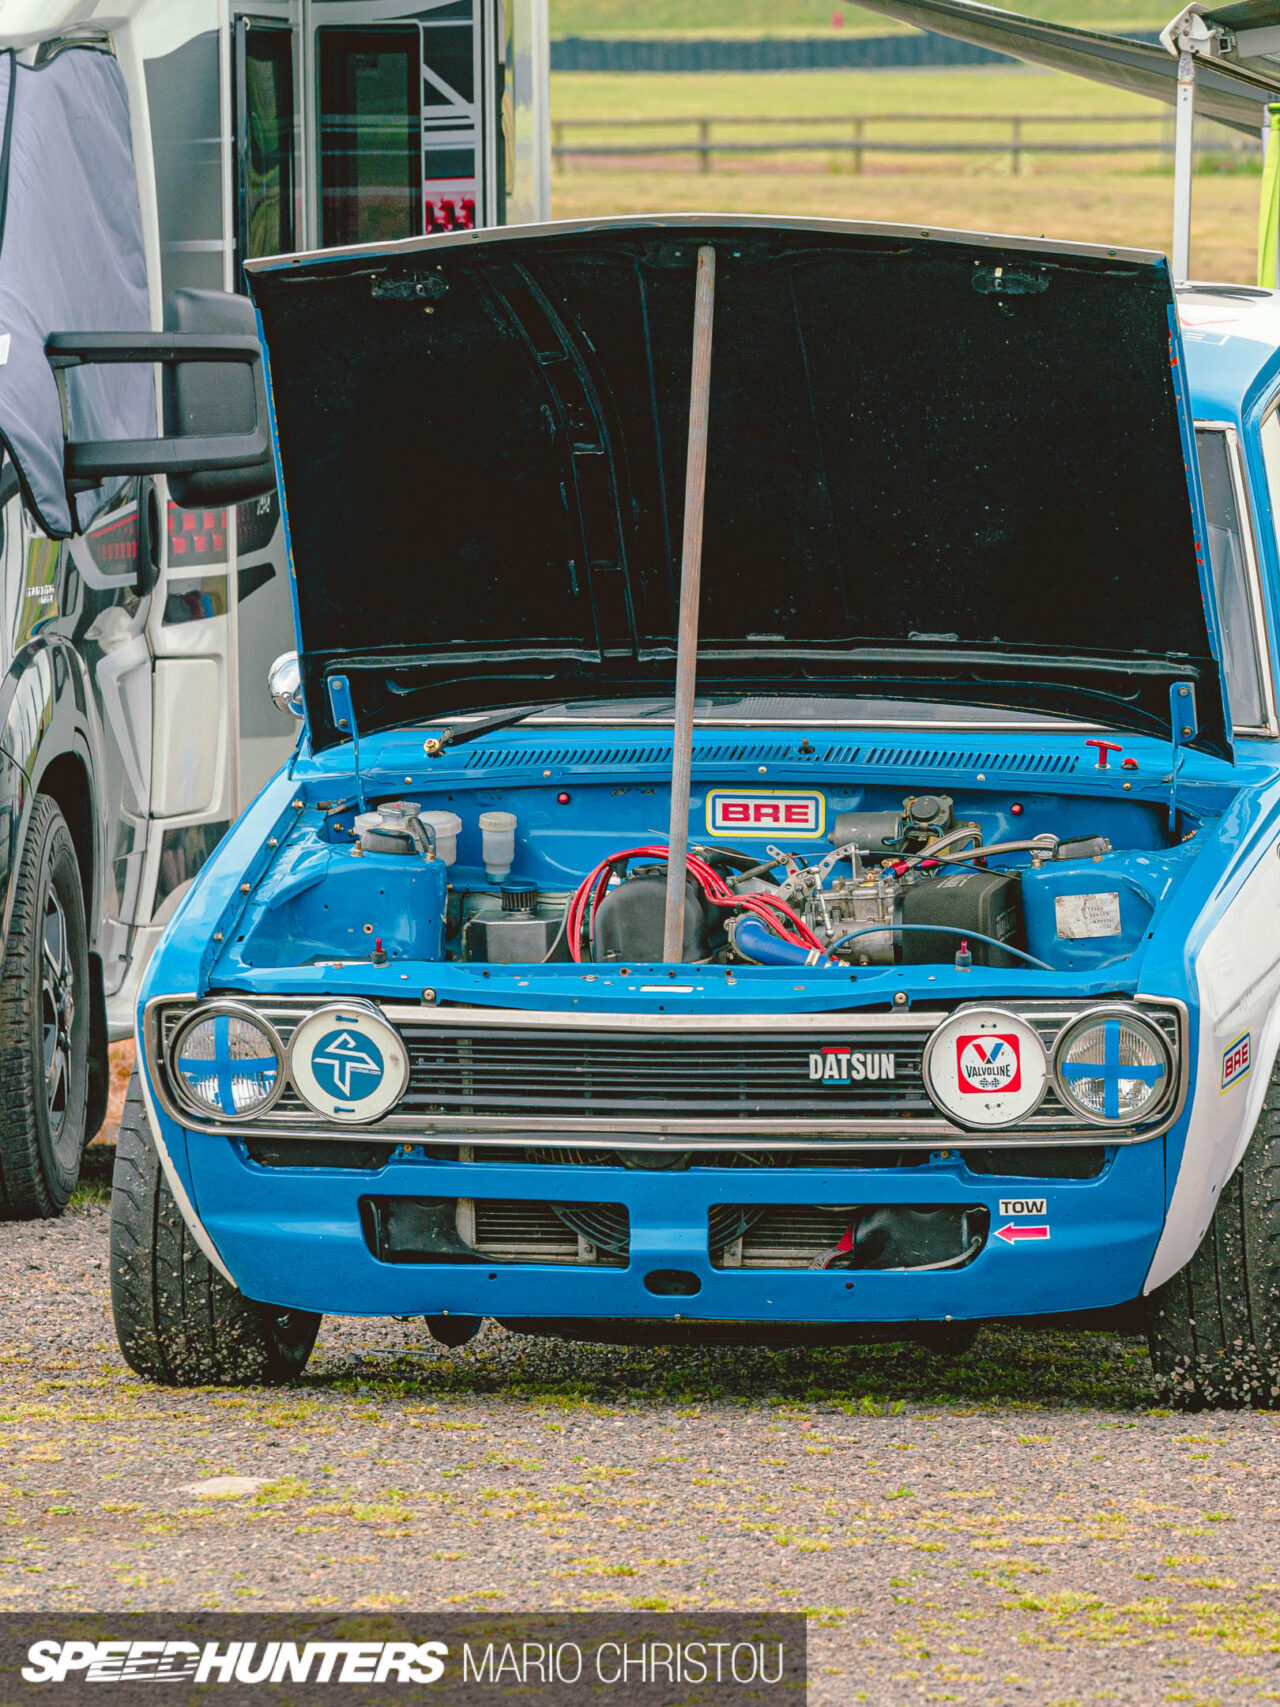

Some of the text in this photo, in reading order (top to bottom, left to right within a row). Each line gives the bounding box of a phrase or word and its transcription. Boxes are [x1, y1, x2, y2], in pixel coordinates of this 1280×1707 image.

[721, 803, 809, 823] BRE
[809, 1053, 895, 1080] DATSUN
[1225, 1042, 1248, 1078] BRE
[965, 1063, 1011, 1078] VALVOLINE
[1001, 1201, 1044, 1214] TOW
